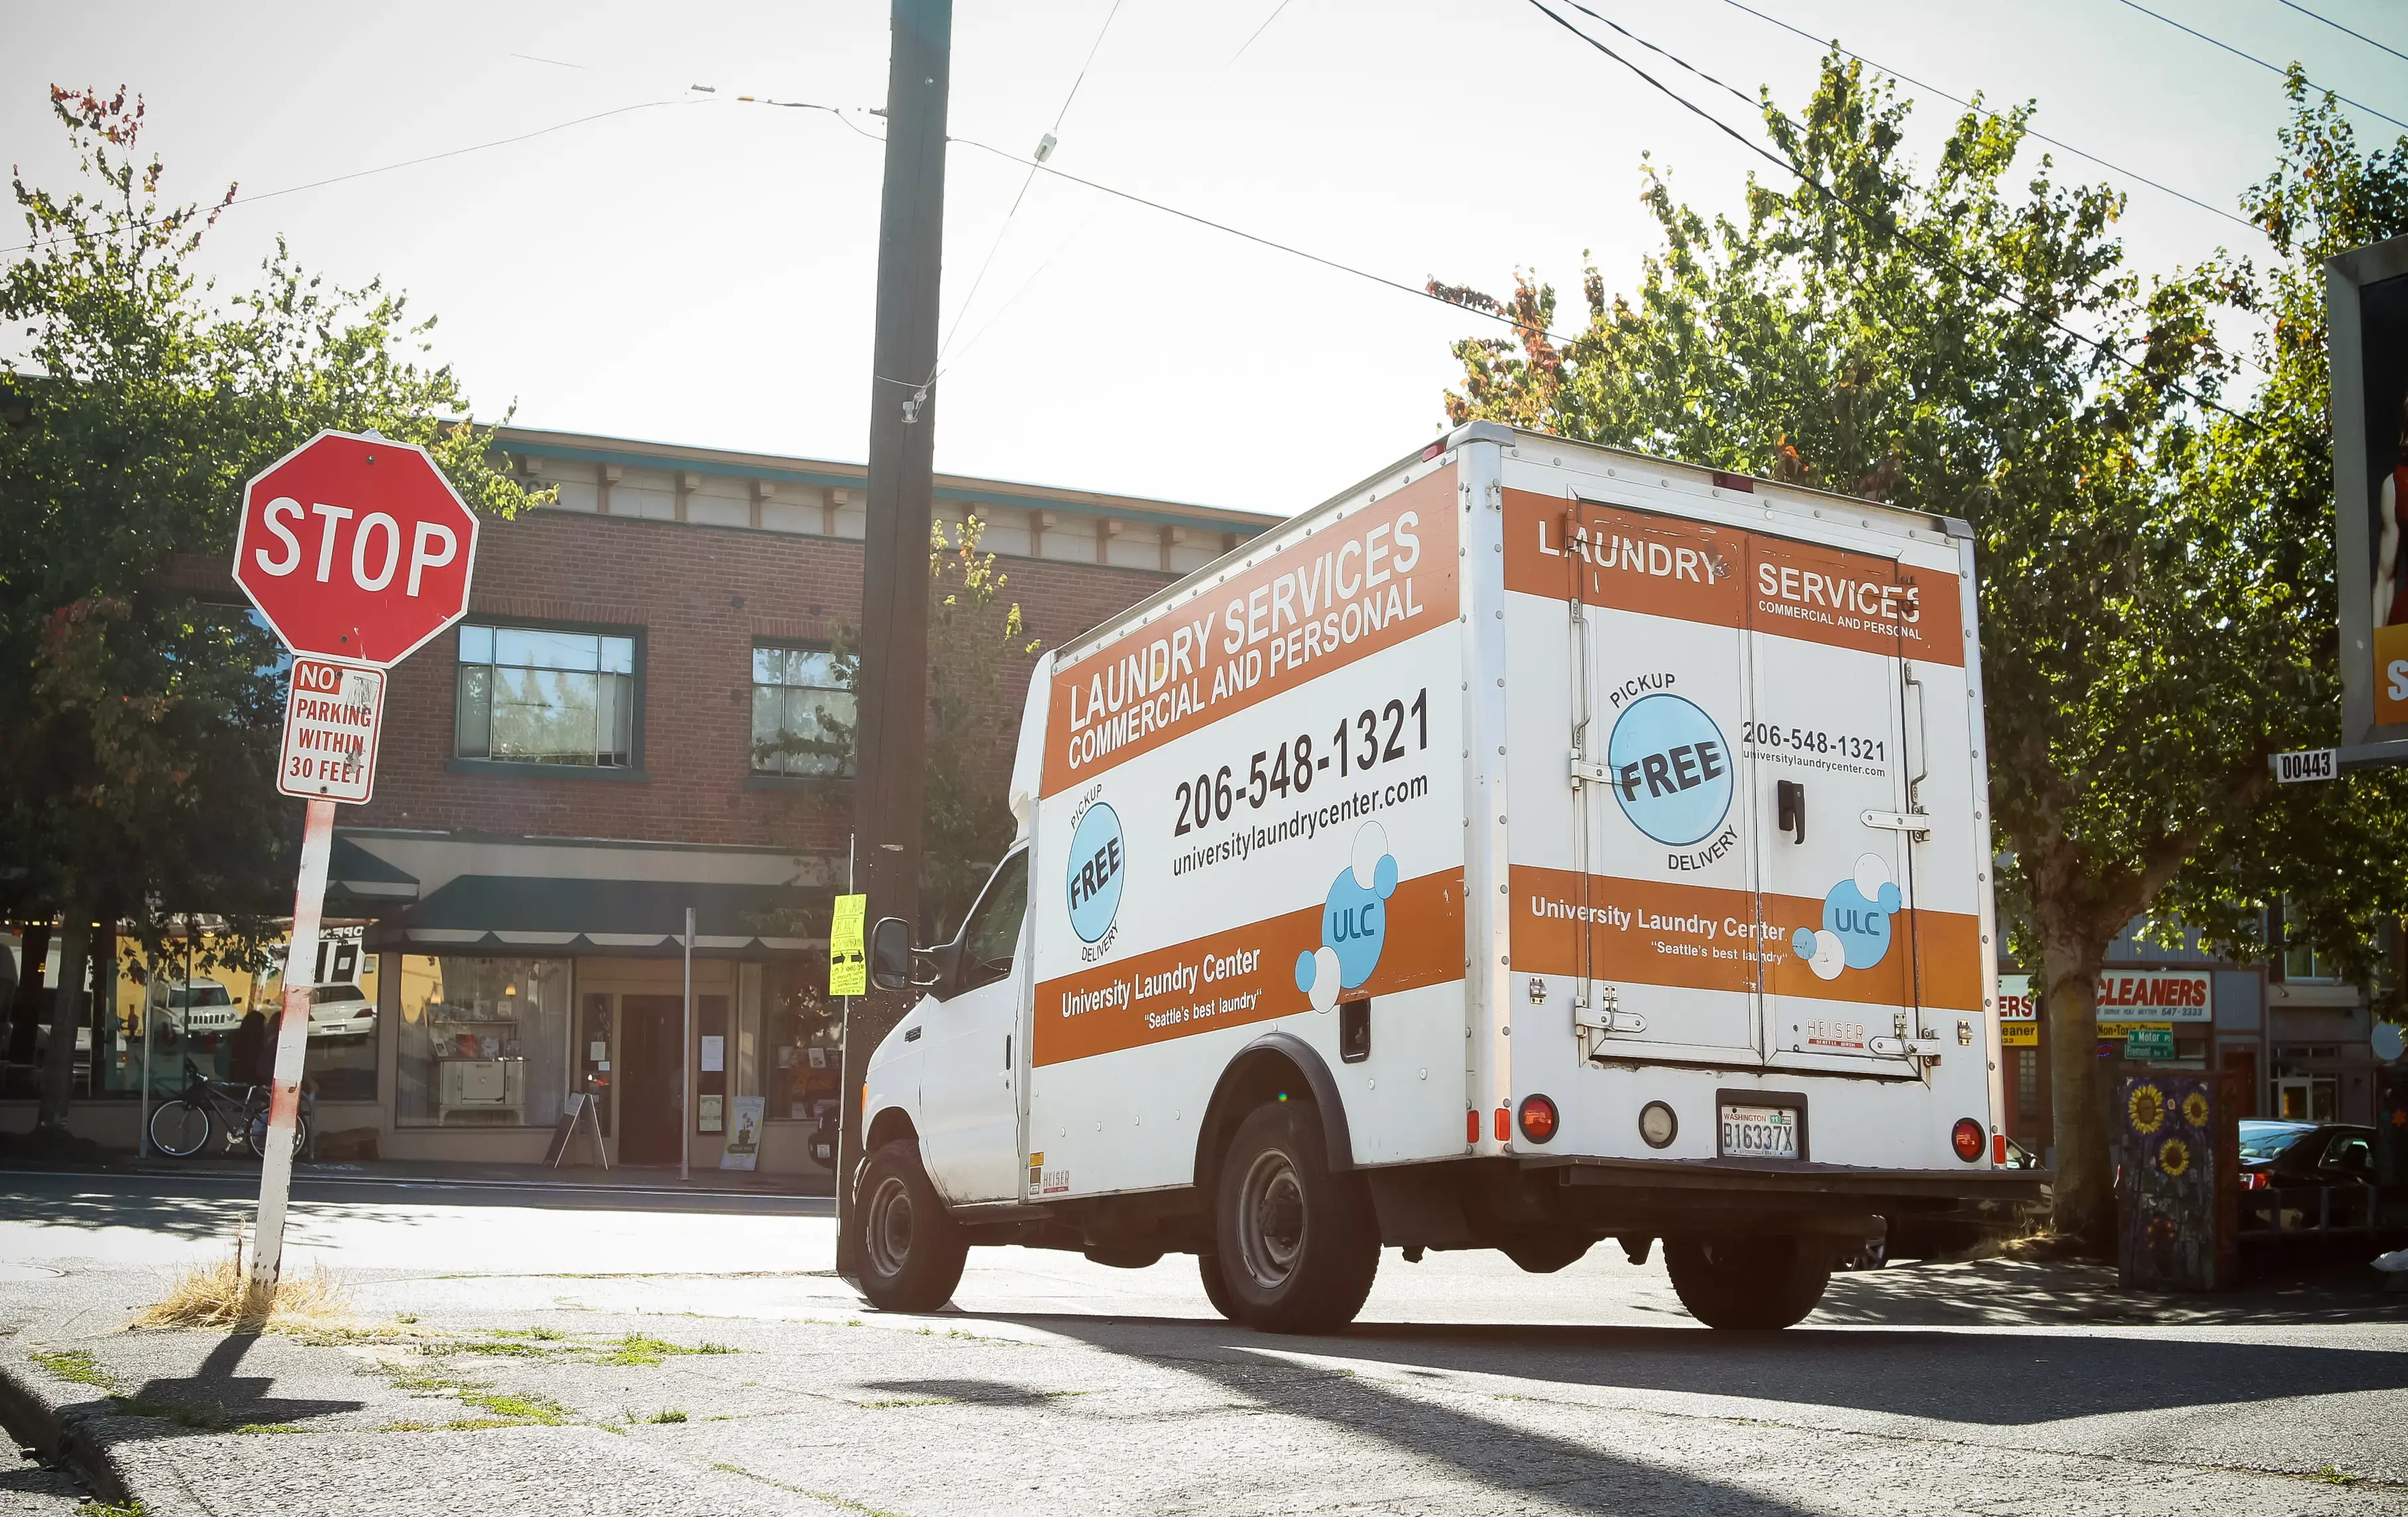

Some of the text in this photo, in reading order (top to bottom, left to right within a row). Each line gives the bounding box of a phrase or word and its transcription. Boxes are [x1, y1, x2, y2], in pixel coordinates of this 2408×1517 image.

[255, 496, 457, 597] STOP
[1538, 520, 1920, 623] LAUNDRY SERVICES
[1070, 511, 1421, 733] LAUNDRY SERVICES
[1758, 600, 1923, 641] COMMERCIAL AND PERSONAL
[299, 664, 336, 691] NO
[1068, 577, 1424, 770] COMMERCIAL AND PERSONAL
[1610, 673, 1675, 709] PICKUP
[296, 699, 372, 728] PARKING
[299, 728, 364, 757] WITHIN
[1743, 721, 1884, 762] 206-548-1321
[289, 756, 365, 785] 30 FEET
[1174, 687, 1428, 838] 206-548-1321
[1620, 741, 1726, 802] FREE
[1744, 750, 1885, 777] universitylaundrycenter.com
[2282, 752, 2331, 780] 00443
[1070, 784, 1102, 830] PICKUP
[1173, 774, 1428, 877] universitylaundrycenter.com
[1668, 824, 1739, 871] DELIVERY
[1070, 836, 1122, 911] FREE
[1334, 903, 1374, 942] ULC
[1531, 895, 1786, 942] University Laundry Center
[1836, 907, 1879, 936] ULC
[1082, 919, 1120, 962] DELIVERY
[1713, 945, 1738, 960] best
[1062, 947, 1261, 1018] University Laundry Center
[2097, 978, 2207, 1007] CLEANERS
[1193, 999, 1215, 1020] best
[1806, 1018, 1864, 1042] HEISER
[2139, 1032, 2161, 1042] Motor
[2127, 1046, 2151, 1056] Fremont
[1724, 1113, 1766, 1122] WASHINGTON
[1724, 1123, 1793, 1151] B16337X
[1043, 1171, 1070, 1187] HEISER
